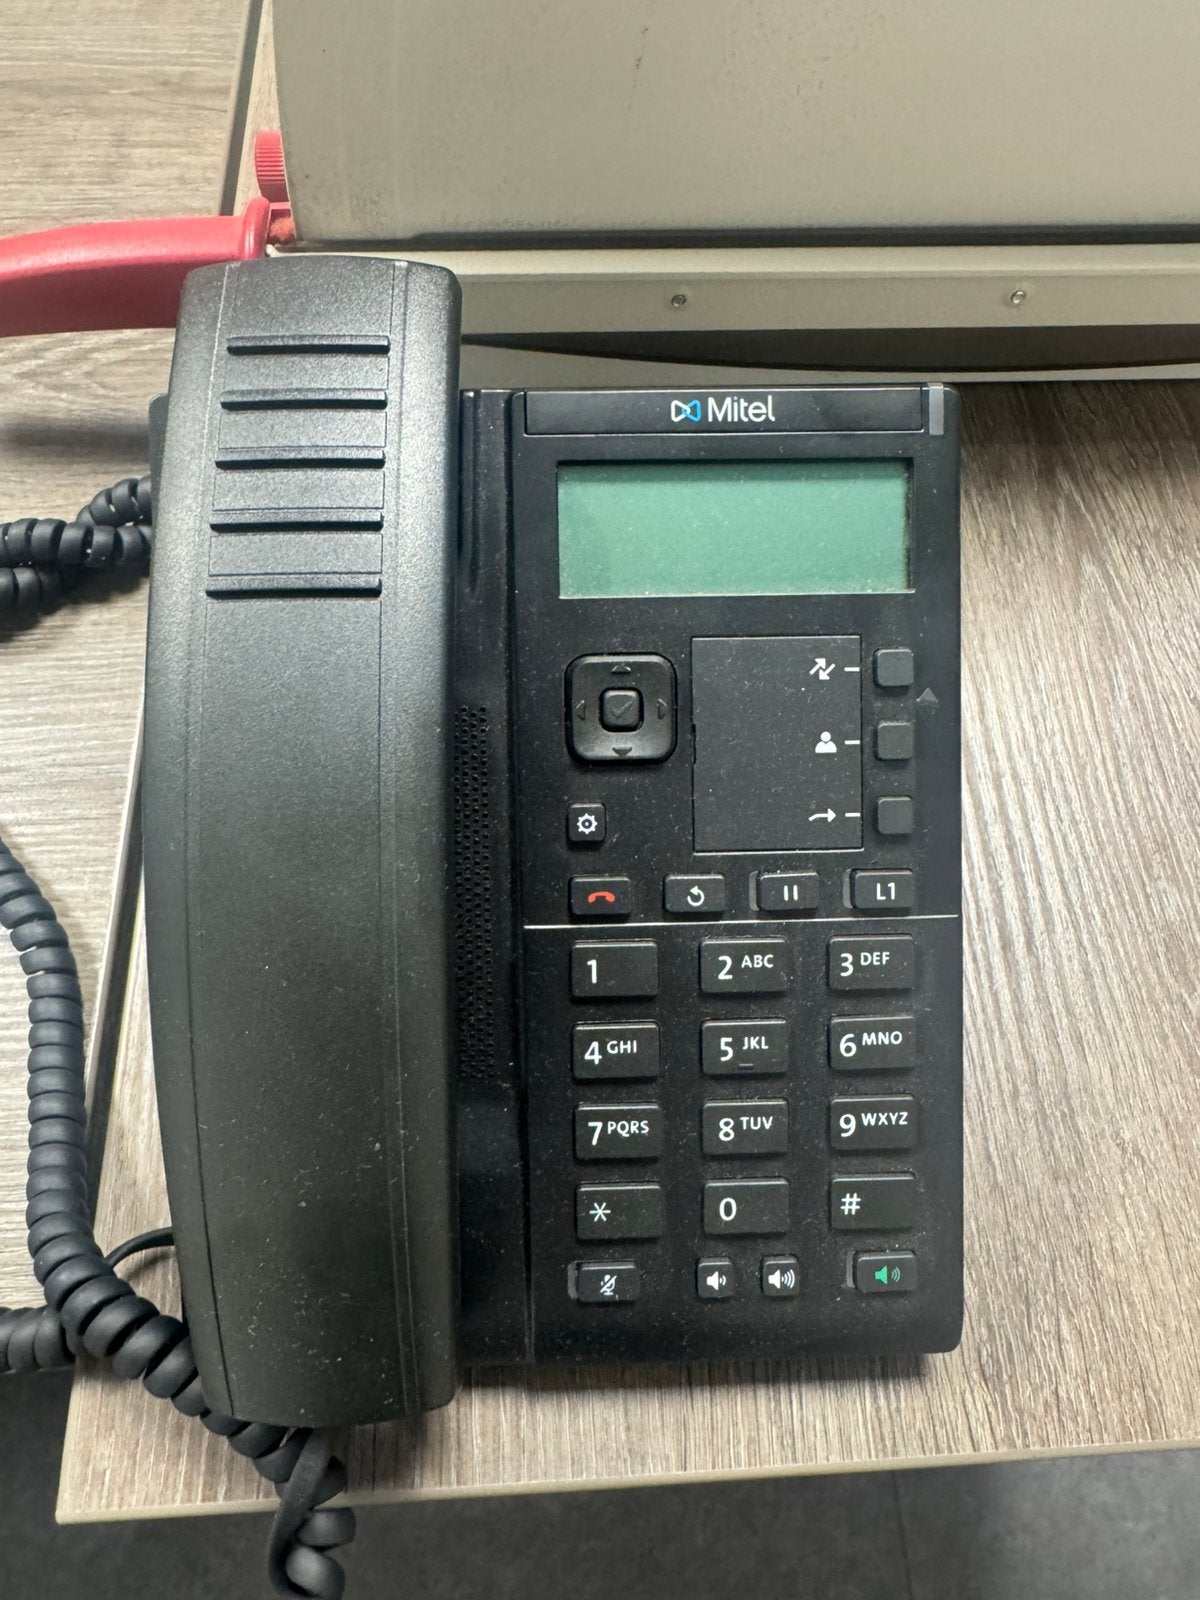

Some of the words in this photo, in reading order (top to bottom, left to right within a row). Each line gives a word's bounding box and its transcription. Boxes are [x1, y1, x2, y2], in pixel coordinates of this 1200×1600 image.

[707, 395, 776, 423] Mitel
[875, 881, 896, 902] L1
[586, 958, 598, 985] 1
[717, 954, 734, 981] 2
[740, 953, 775, 969] ABC
[839, 952, 855, 978] 3
[859, 950, 891, 967] DEF
[583, 1040, 603, 1066] 4
[606, 1039, 638, 1055] GHI
[719, 1036, 734, 1063] 5
[741, 1035, 770, 1051] JKL
[838, 1032, 858, 1058] 6
[861, 1030, 903, 1047] MNO
[587, 1121, 604, 1146] 7
[607, 1119, 650, 1138] PQRS
[718, 1117, 736, 1142] 8
[739, 1115, 774, 1131] TUV
[838, 1113, 857, 1138] 9
[860, 1110, 909, 1127] WXYZ
[718, 1196, 738, 1223] 0
[839, 1192, 862, 1216] #
